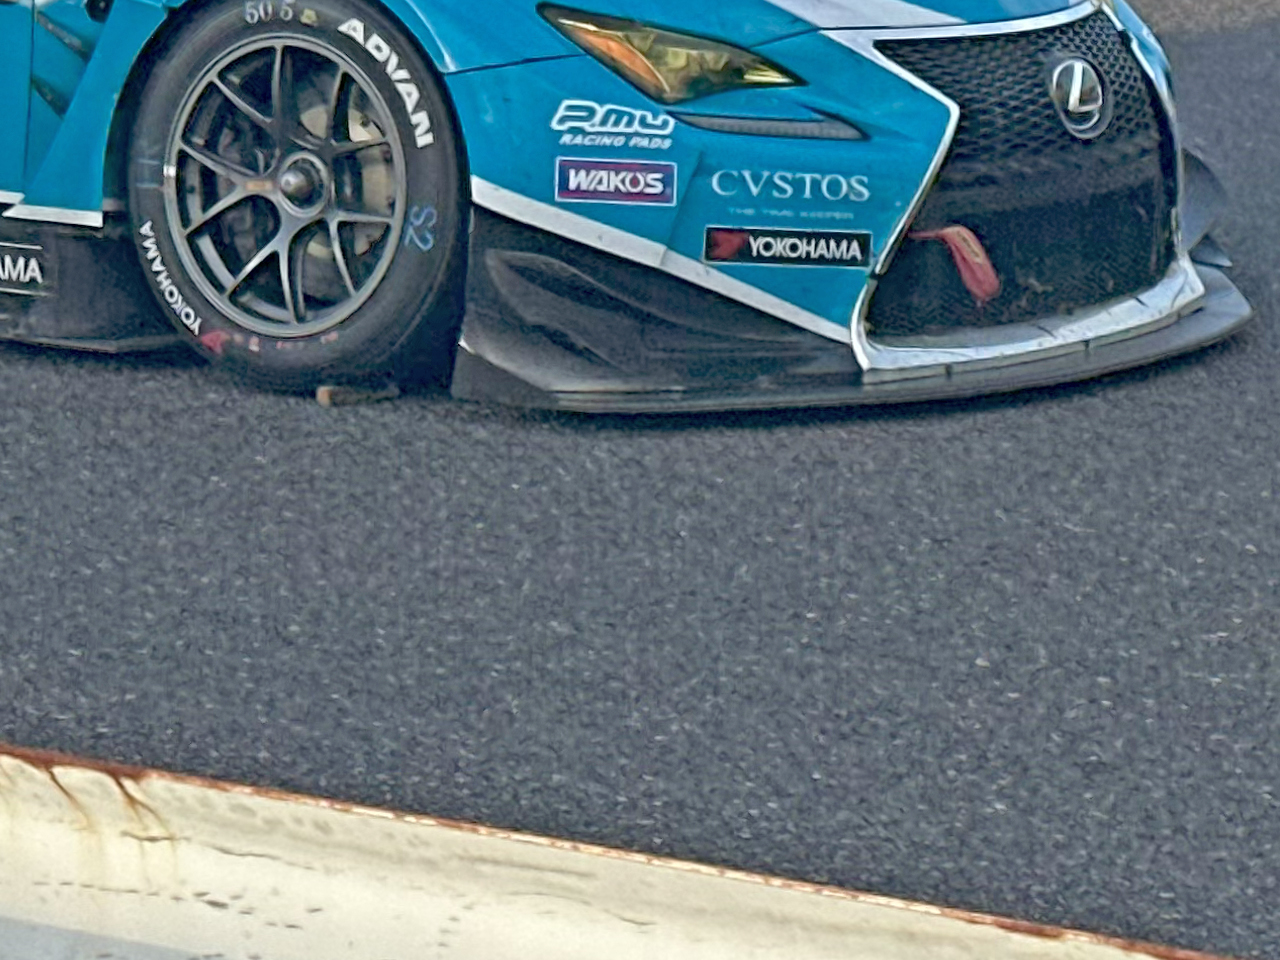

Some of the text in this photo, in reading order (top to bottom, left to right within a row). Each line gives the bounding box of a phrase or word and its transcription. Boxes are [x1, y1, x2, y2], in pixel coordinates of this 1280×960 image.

[336, 17, 435, 149] ADVAN
[559, 133, 673, 150] RACING PADS
[711, 170, 871, 202] CVSTOS
[749, 235, 863, 262] YOKOHAMA
[138, 219, 203, 336] YOKOHAMA
